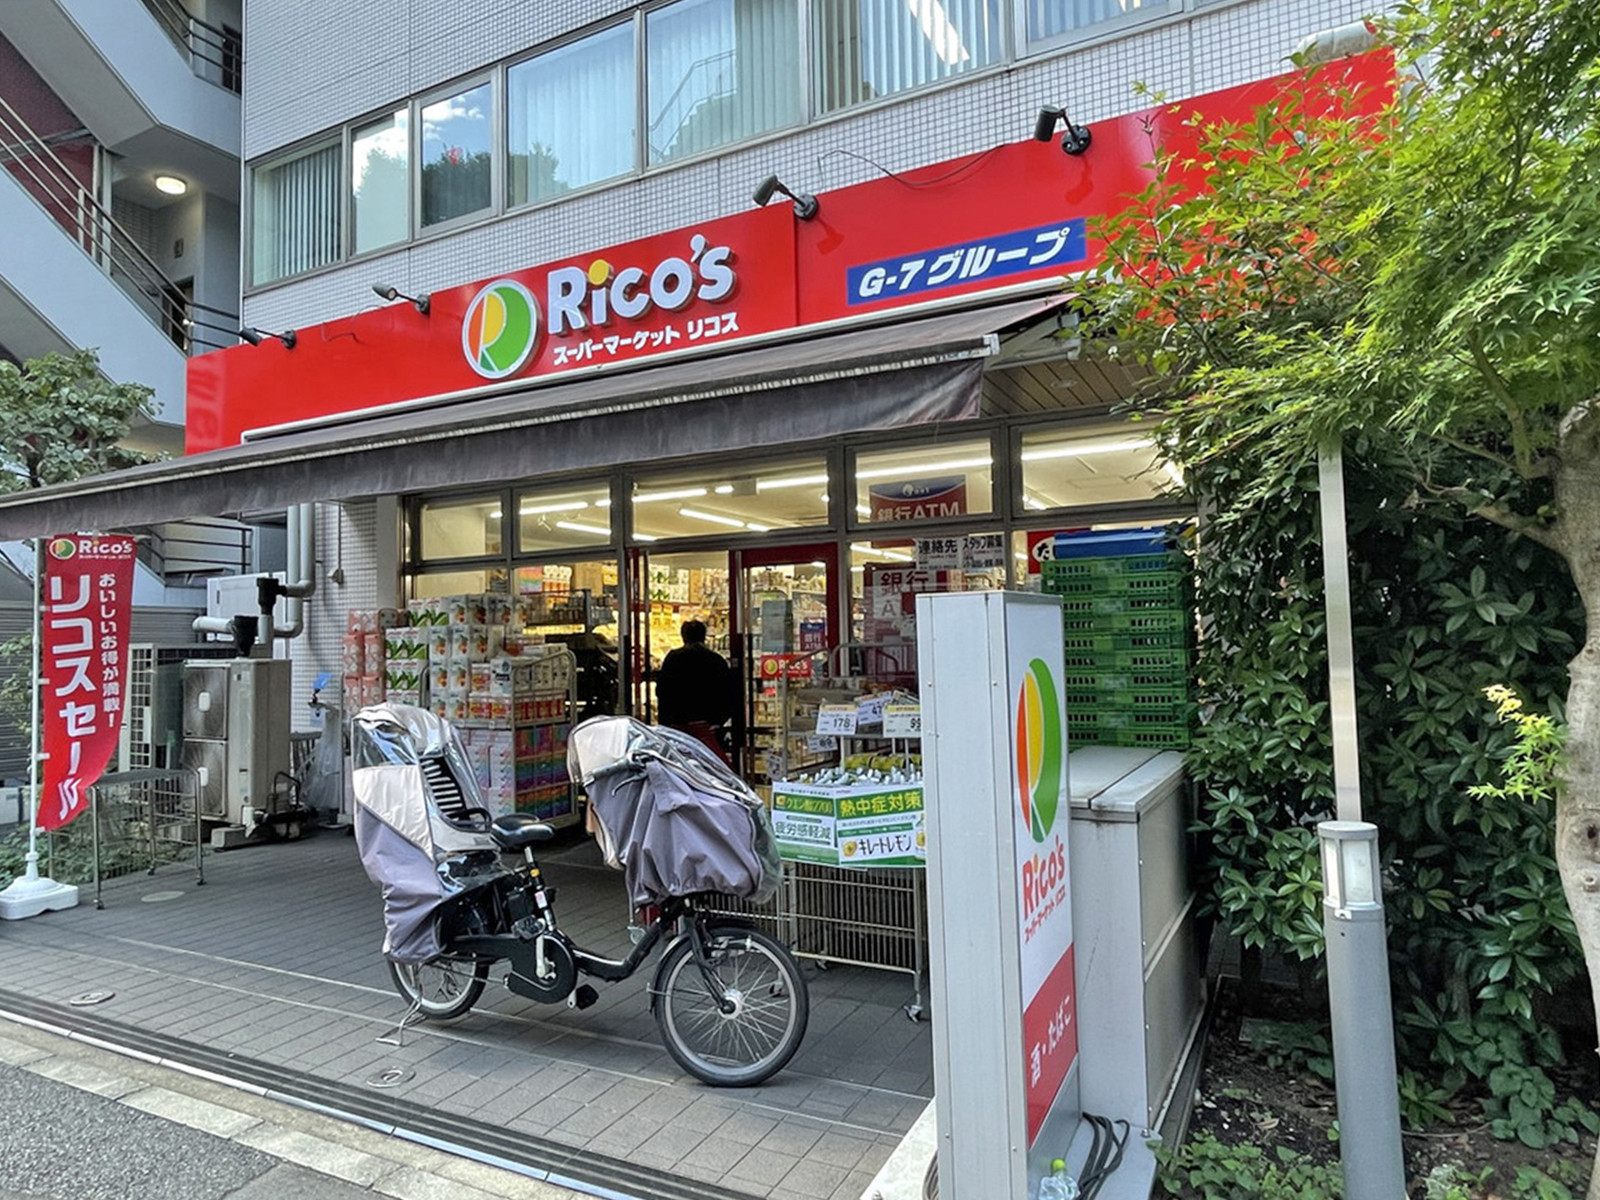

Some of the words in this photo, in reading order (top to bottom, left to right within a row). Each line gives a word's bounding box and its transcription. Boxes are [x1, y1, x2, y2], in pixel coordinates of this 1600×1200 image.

[548, 234, 736, 337] Rico's
[857, 226, 1070, 299] G-7グループ
[553, 326, 681, 367] スーパーマーケット
[687, 311, 739, 340] リコス
[877, 501, 960, 521] 銀行ATM
[78, 539, 133, 555] Rico's
[50, 574, 97, 821] リコスセール
[839, 790, 922, 817] 熱中症対策
[859, 834, 912, 856] キレートレモン
[1022, 834, 1065, 921] Rico's
[1030, 995, 1072, 1089] 酒・たばこ
